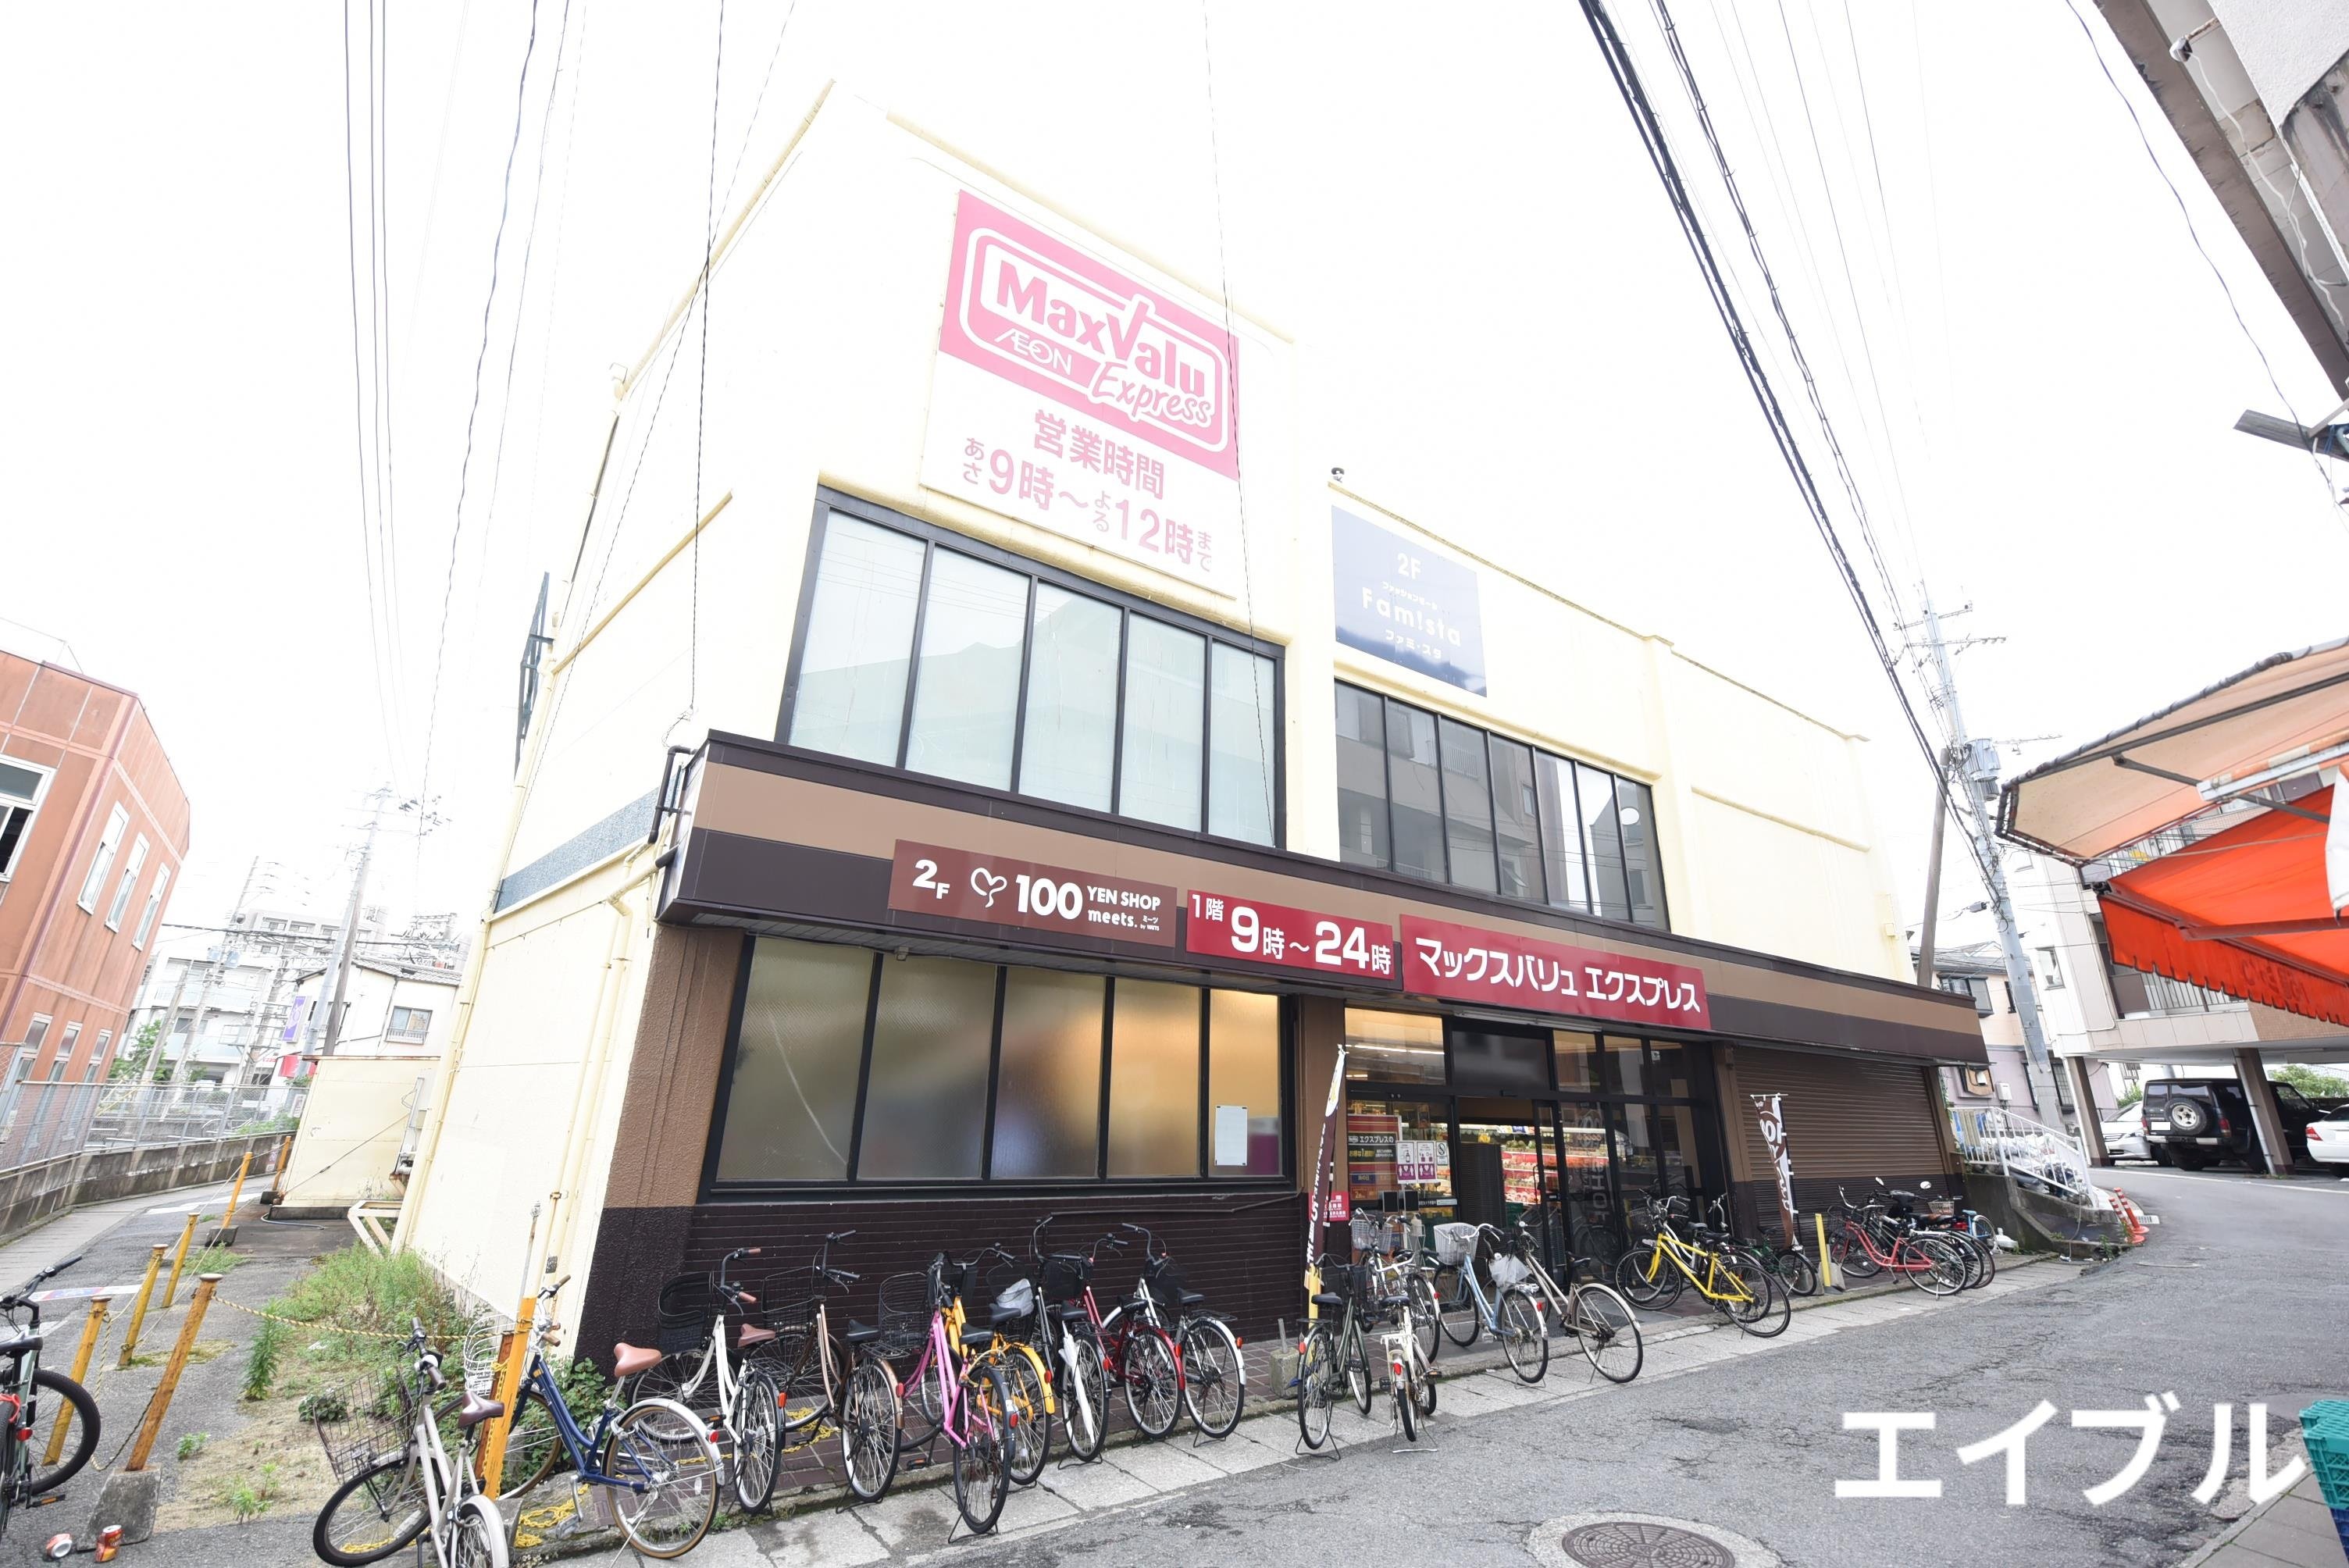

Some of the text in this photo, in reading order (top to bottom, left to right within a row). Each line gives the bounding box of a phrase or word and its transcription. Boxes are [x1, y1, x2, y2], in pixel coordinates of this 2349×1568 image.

[996, 259, 1206, 397] MaxValu
[1092, 361, 1213, 426] Express
[1034, 408, 1164, 501] 営業時間
[1397, 553, 1421, 579] 2F
[912, 859, 950, 900] 2F
[1015, 874, 1161, 920] 100 YEN SHOP
[1192, 893, 1224, 922] 1階
[1415, 936, 1701, 1013] マックスバリュ エクスプレス
